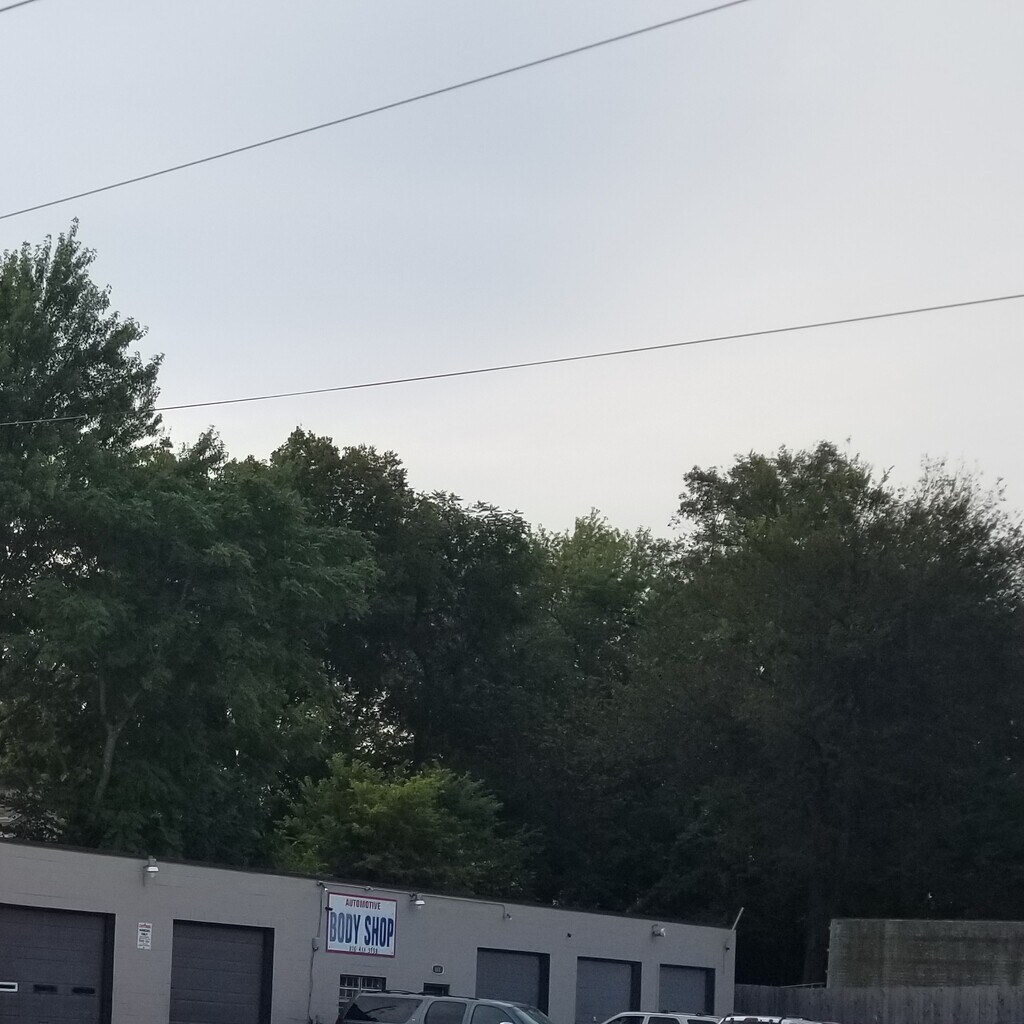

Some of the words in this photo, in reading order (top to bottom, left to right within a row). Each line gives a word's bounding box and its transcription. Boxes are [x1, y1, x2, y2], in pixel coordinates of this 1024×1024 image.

[345, 898, 381, 910] AUTOMOTIVE
[329, 912, 361, 944] BODY
[364, 915, 394, 947] SHOP
